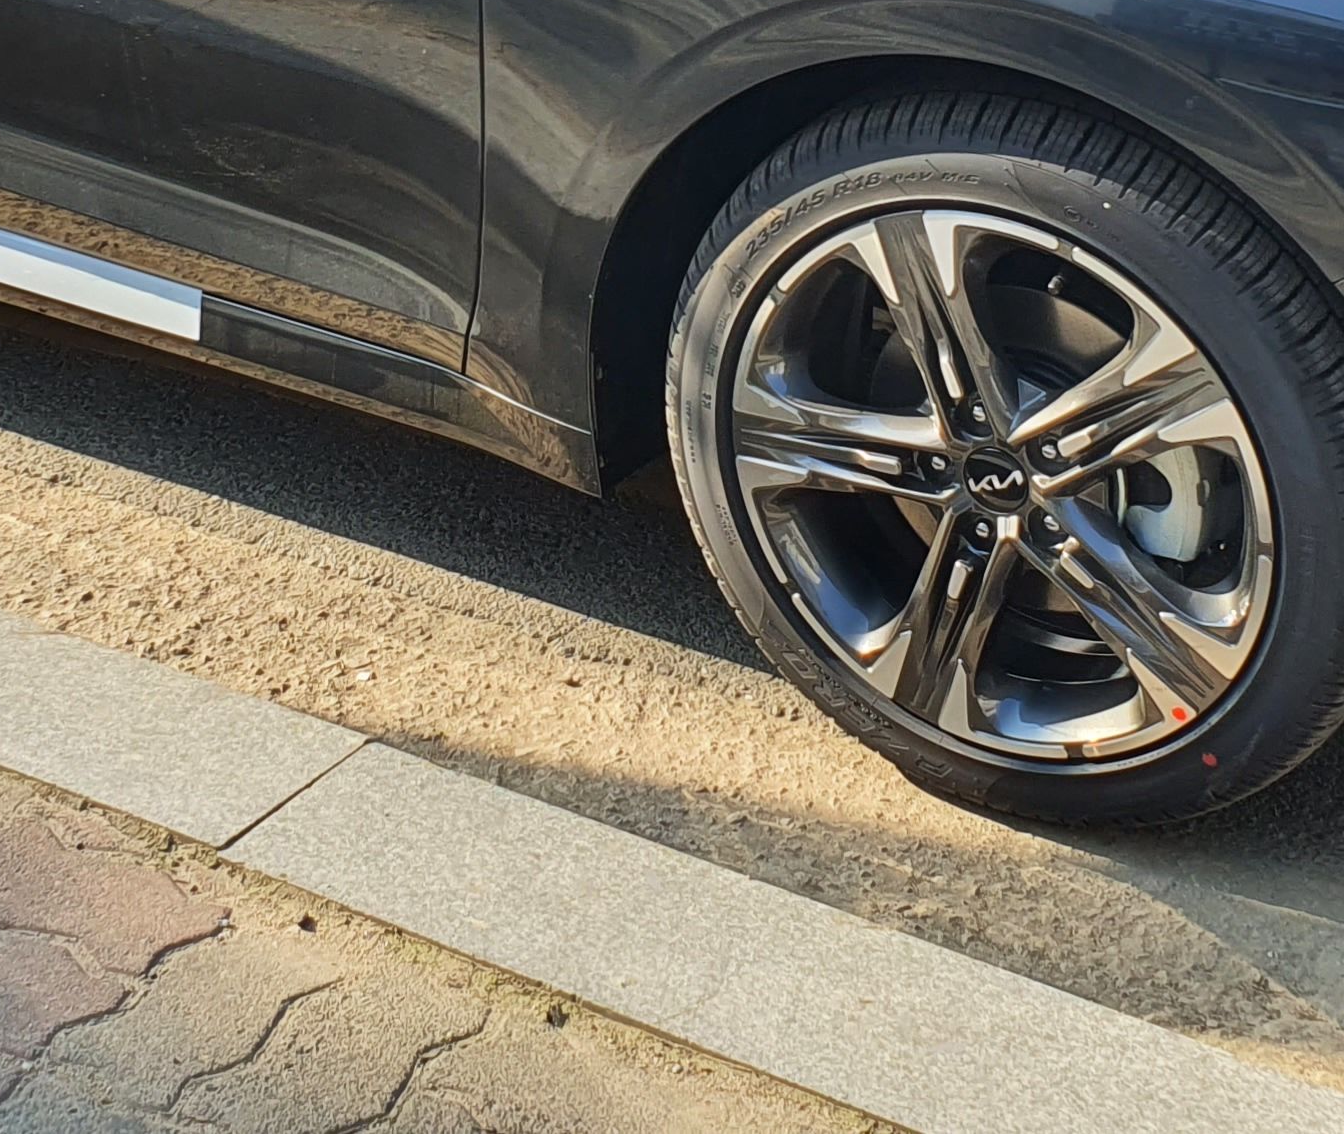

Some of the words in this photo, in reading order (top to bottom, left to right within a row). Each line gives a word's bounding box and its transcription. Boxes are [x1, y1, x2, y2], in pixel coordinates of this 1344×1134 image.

[744, 189, 826, 259] 235/45
[832, 171, 882, 199] R18
[967, 469, 1024, 493] KIA
